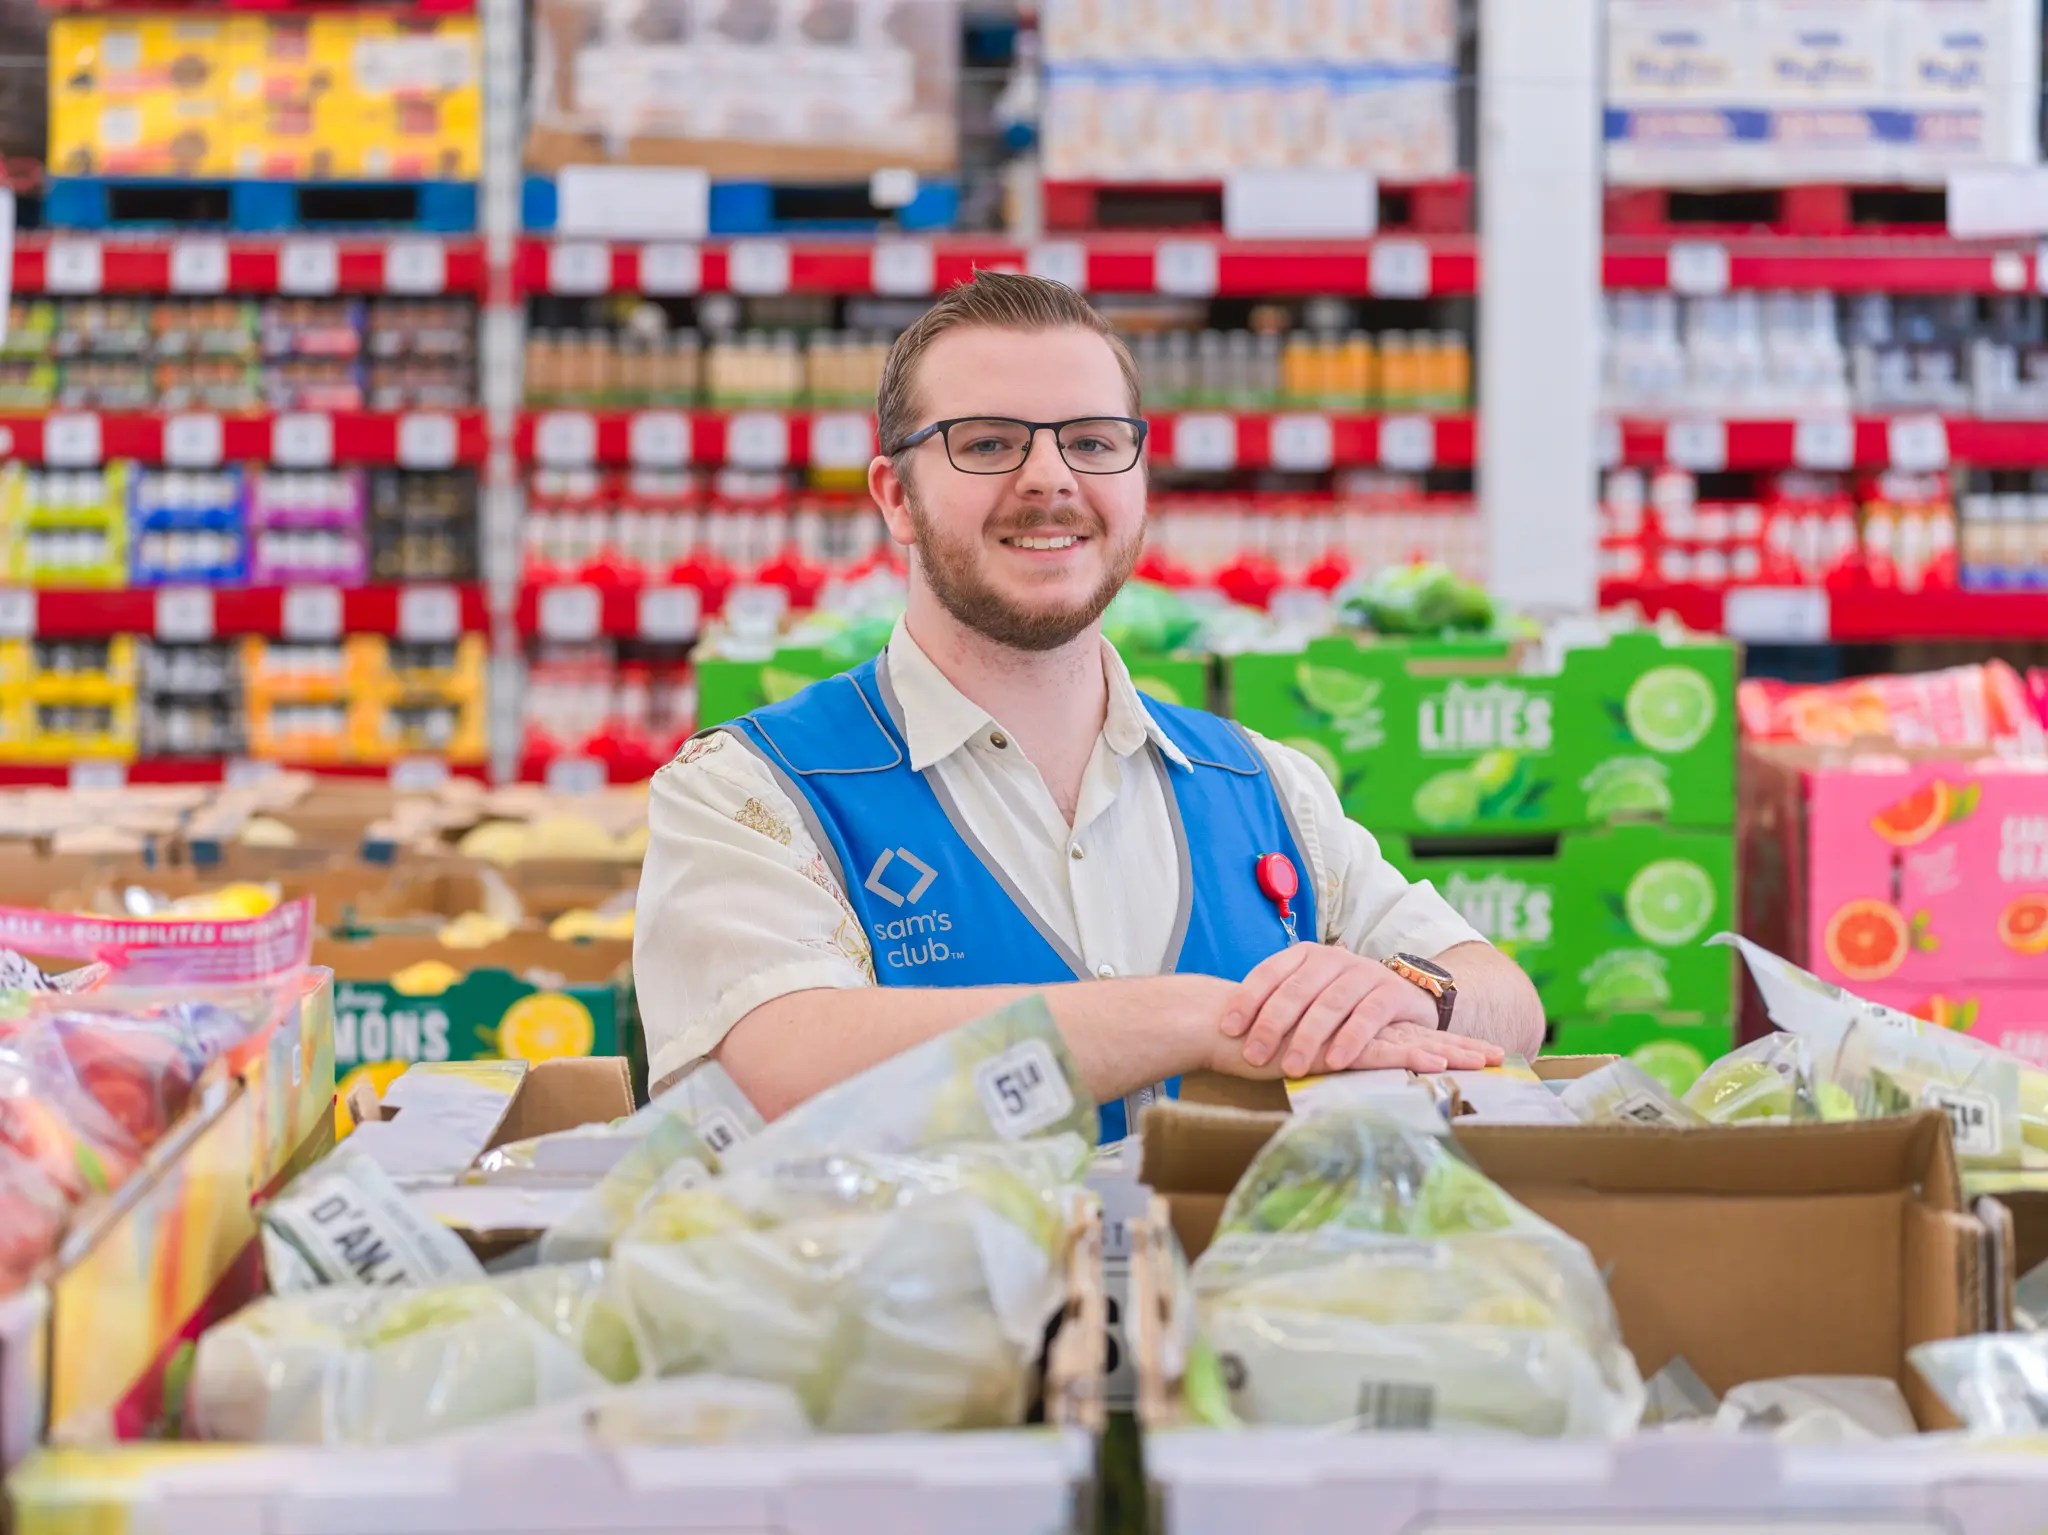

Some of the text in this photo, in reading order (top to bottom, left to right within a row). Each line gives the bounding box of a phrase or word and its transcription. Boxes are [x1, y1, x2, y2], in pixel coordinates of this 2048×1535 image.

[1418, 697, 1553, 750] LIMES
[874, 909, 952, 940] sam's
[887, 937, 950, 968] club
